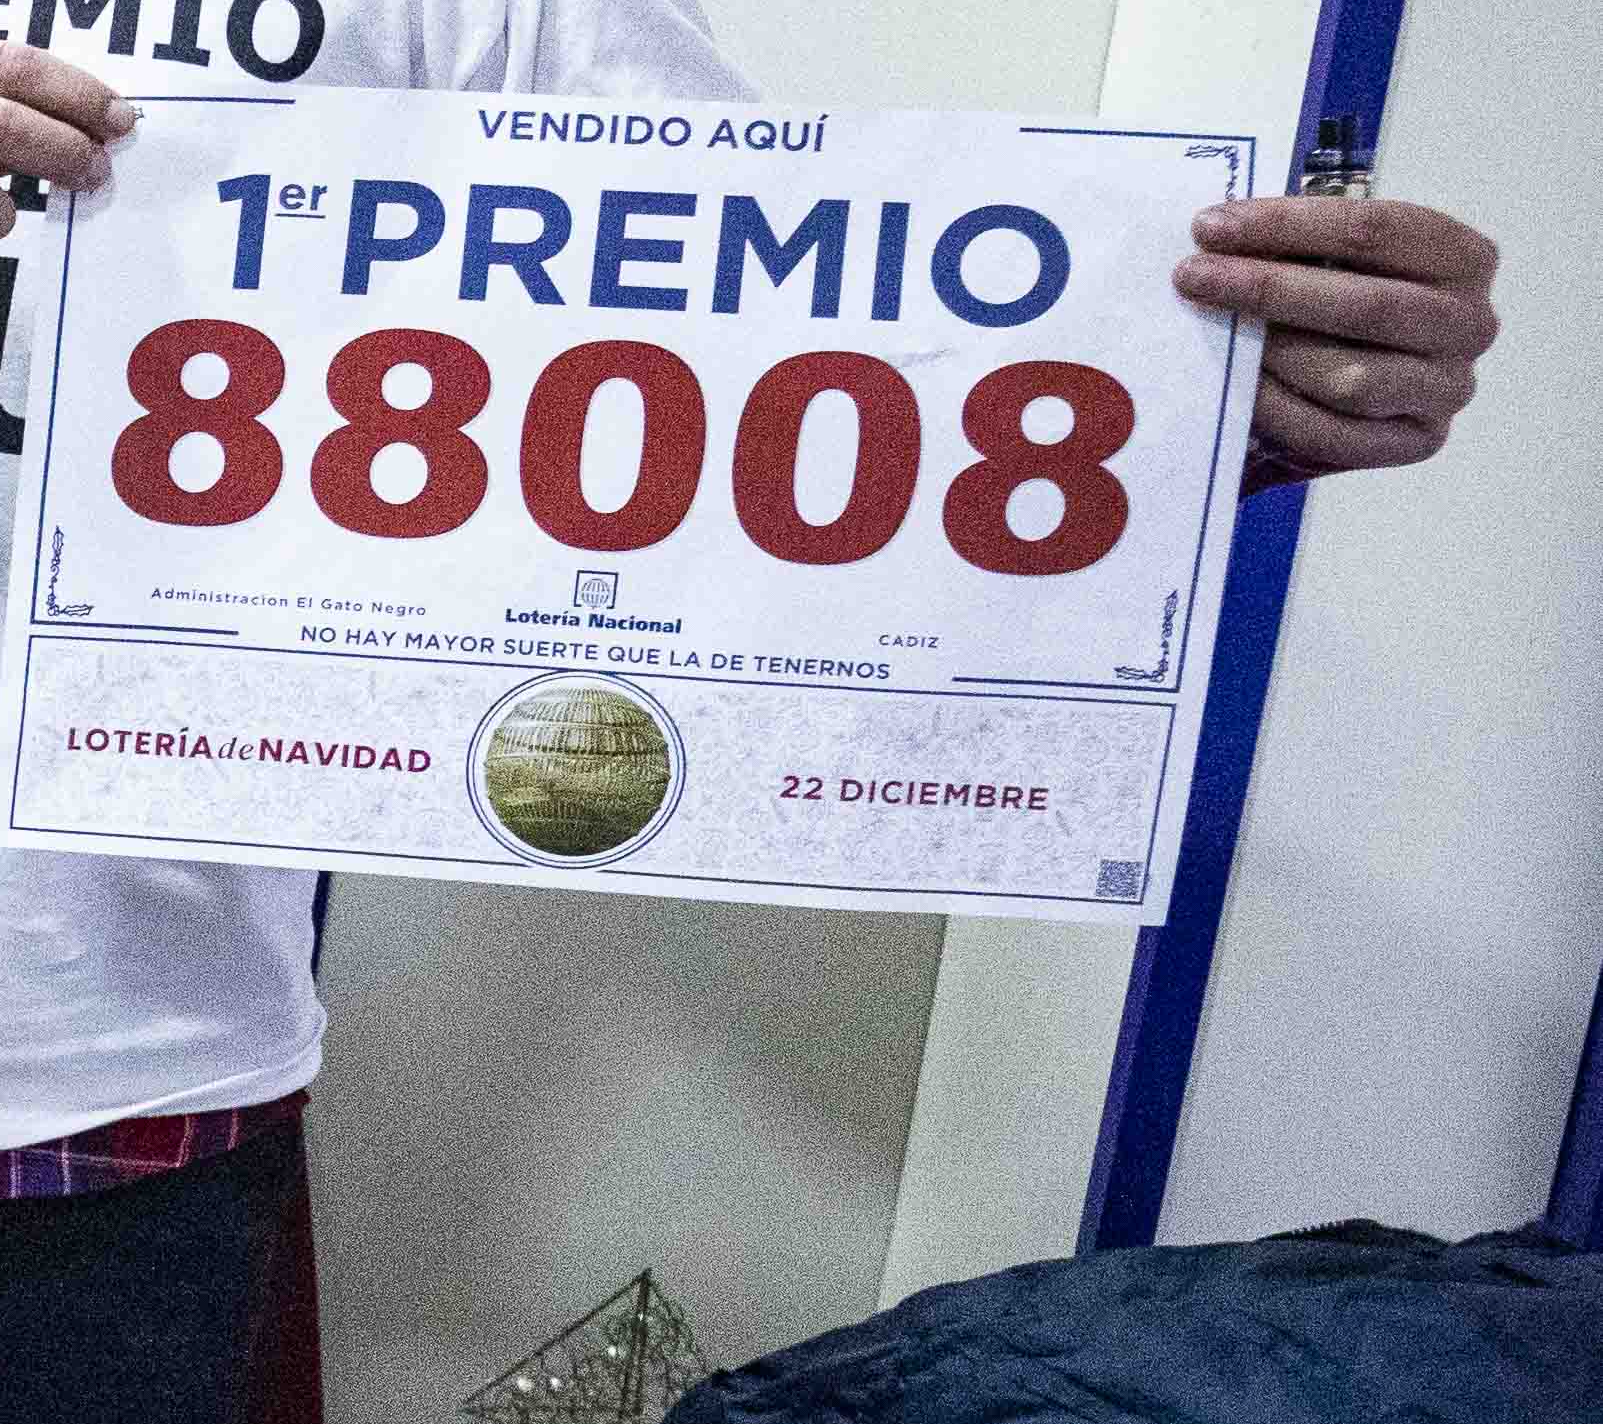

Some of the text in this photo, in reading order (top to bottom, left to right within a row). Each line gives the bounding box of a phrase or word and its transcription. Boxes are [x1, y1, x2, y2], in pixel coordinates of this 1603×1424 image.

[477, 107, 827, 156] VENDIDO AQUÍ
[217, 171, 1071, 329] 1er PREMIO
[109, 317, 1138, 576] 88008
[151, 587, 427, 617] Administracion El Gato Negro
[504, 607, 681, 635] Lotería Nacional
[300, 624, 892, 680] NO HAY MAYOR SUERTE QUE LA DE TENERNOS
[879, 634, 939, 649] CADIZ
[778, 774, 1051, 812] 22 DICIEMBRE
